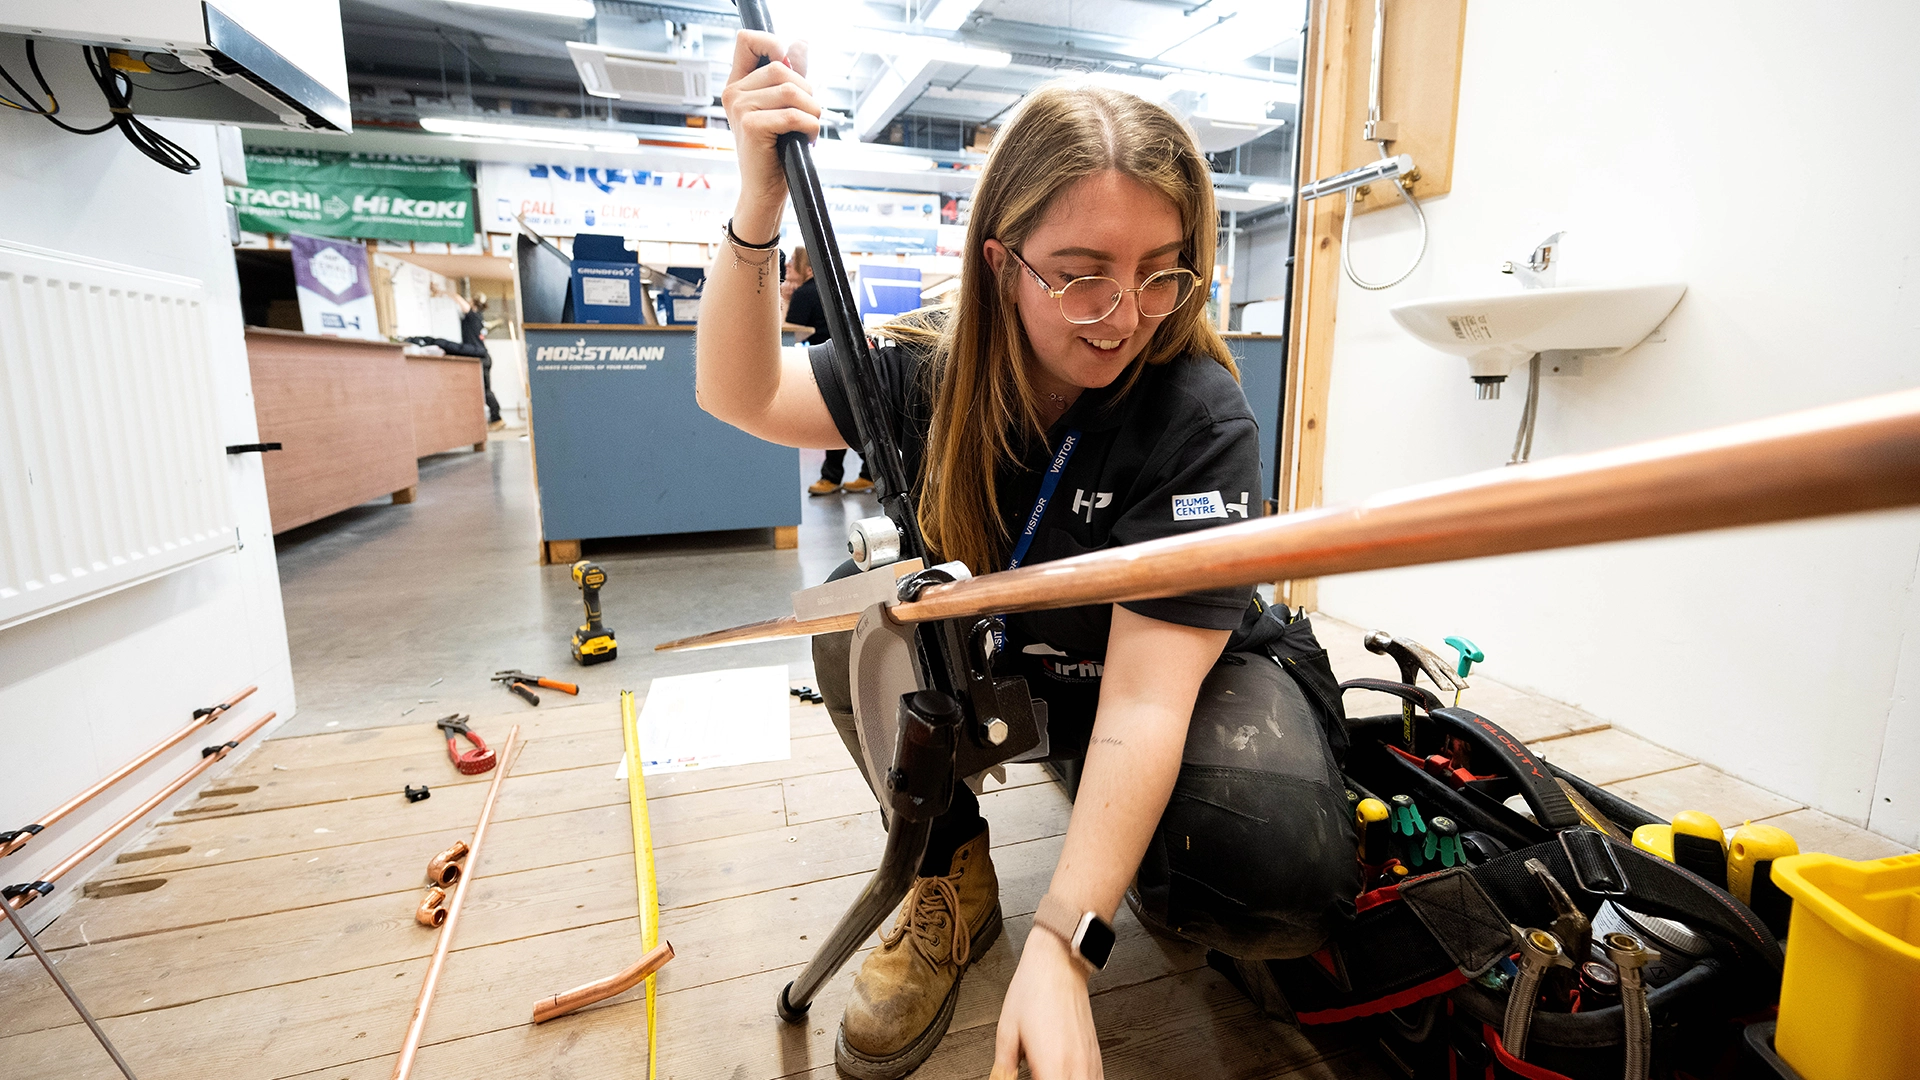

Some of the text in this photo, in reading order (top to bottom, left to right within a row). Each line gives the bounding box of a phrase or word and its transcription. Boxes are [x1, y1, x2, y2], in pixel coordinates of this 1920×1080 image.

[226, 186, 467, 219] ITACHI HiKOKI
[521, 199, 556, 216] CALL
[601, 204, 641, 219] CLICK
[576, 267, 625, 276] GRUNDFOS
[536, 346, 665, 362] HORSTMANN
[536, 364, 560, 372] ALWAYS
[606, 363, 621, 371] YOUR
[622, 363, 648, 371] HEATING
[1050, 435, 1077, 474] VISITOR
[1175, 496, 1210, 507] PLUMB
[1024, 497, 1047, 535] VISITOR
[1176, 505, 1216, 516] CENTRE
[1473, 717, 1545, 779] VELOCITY
